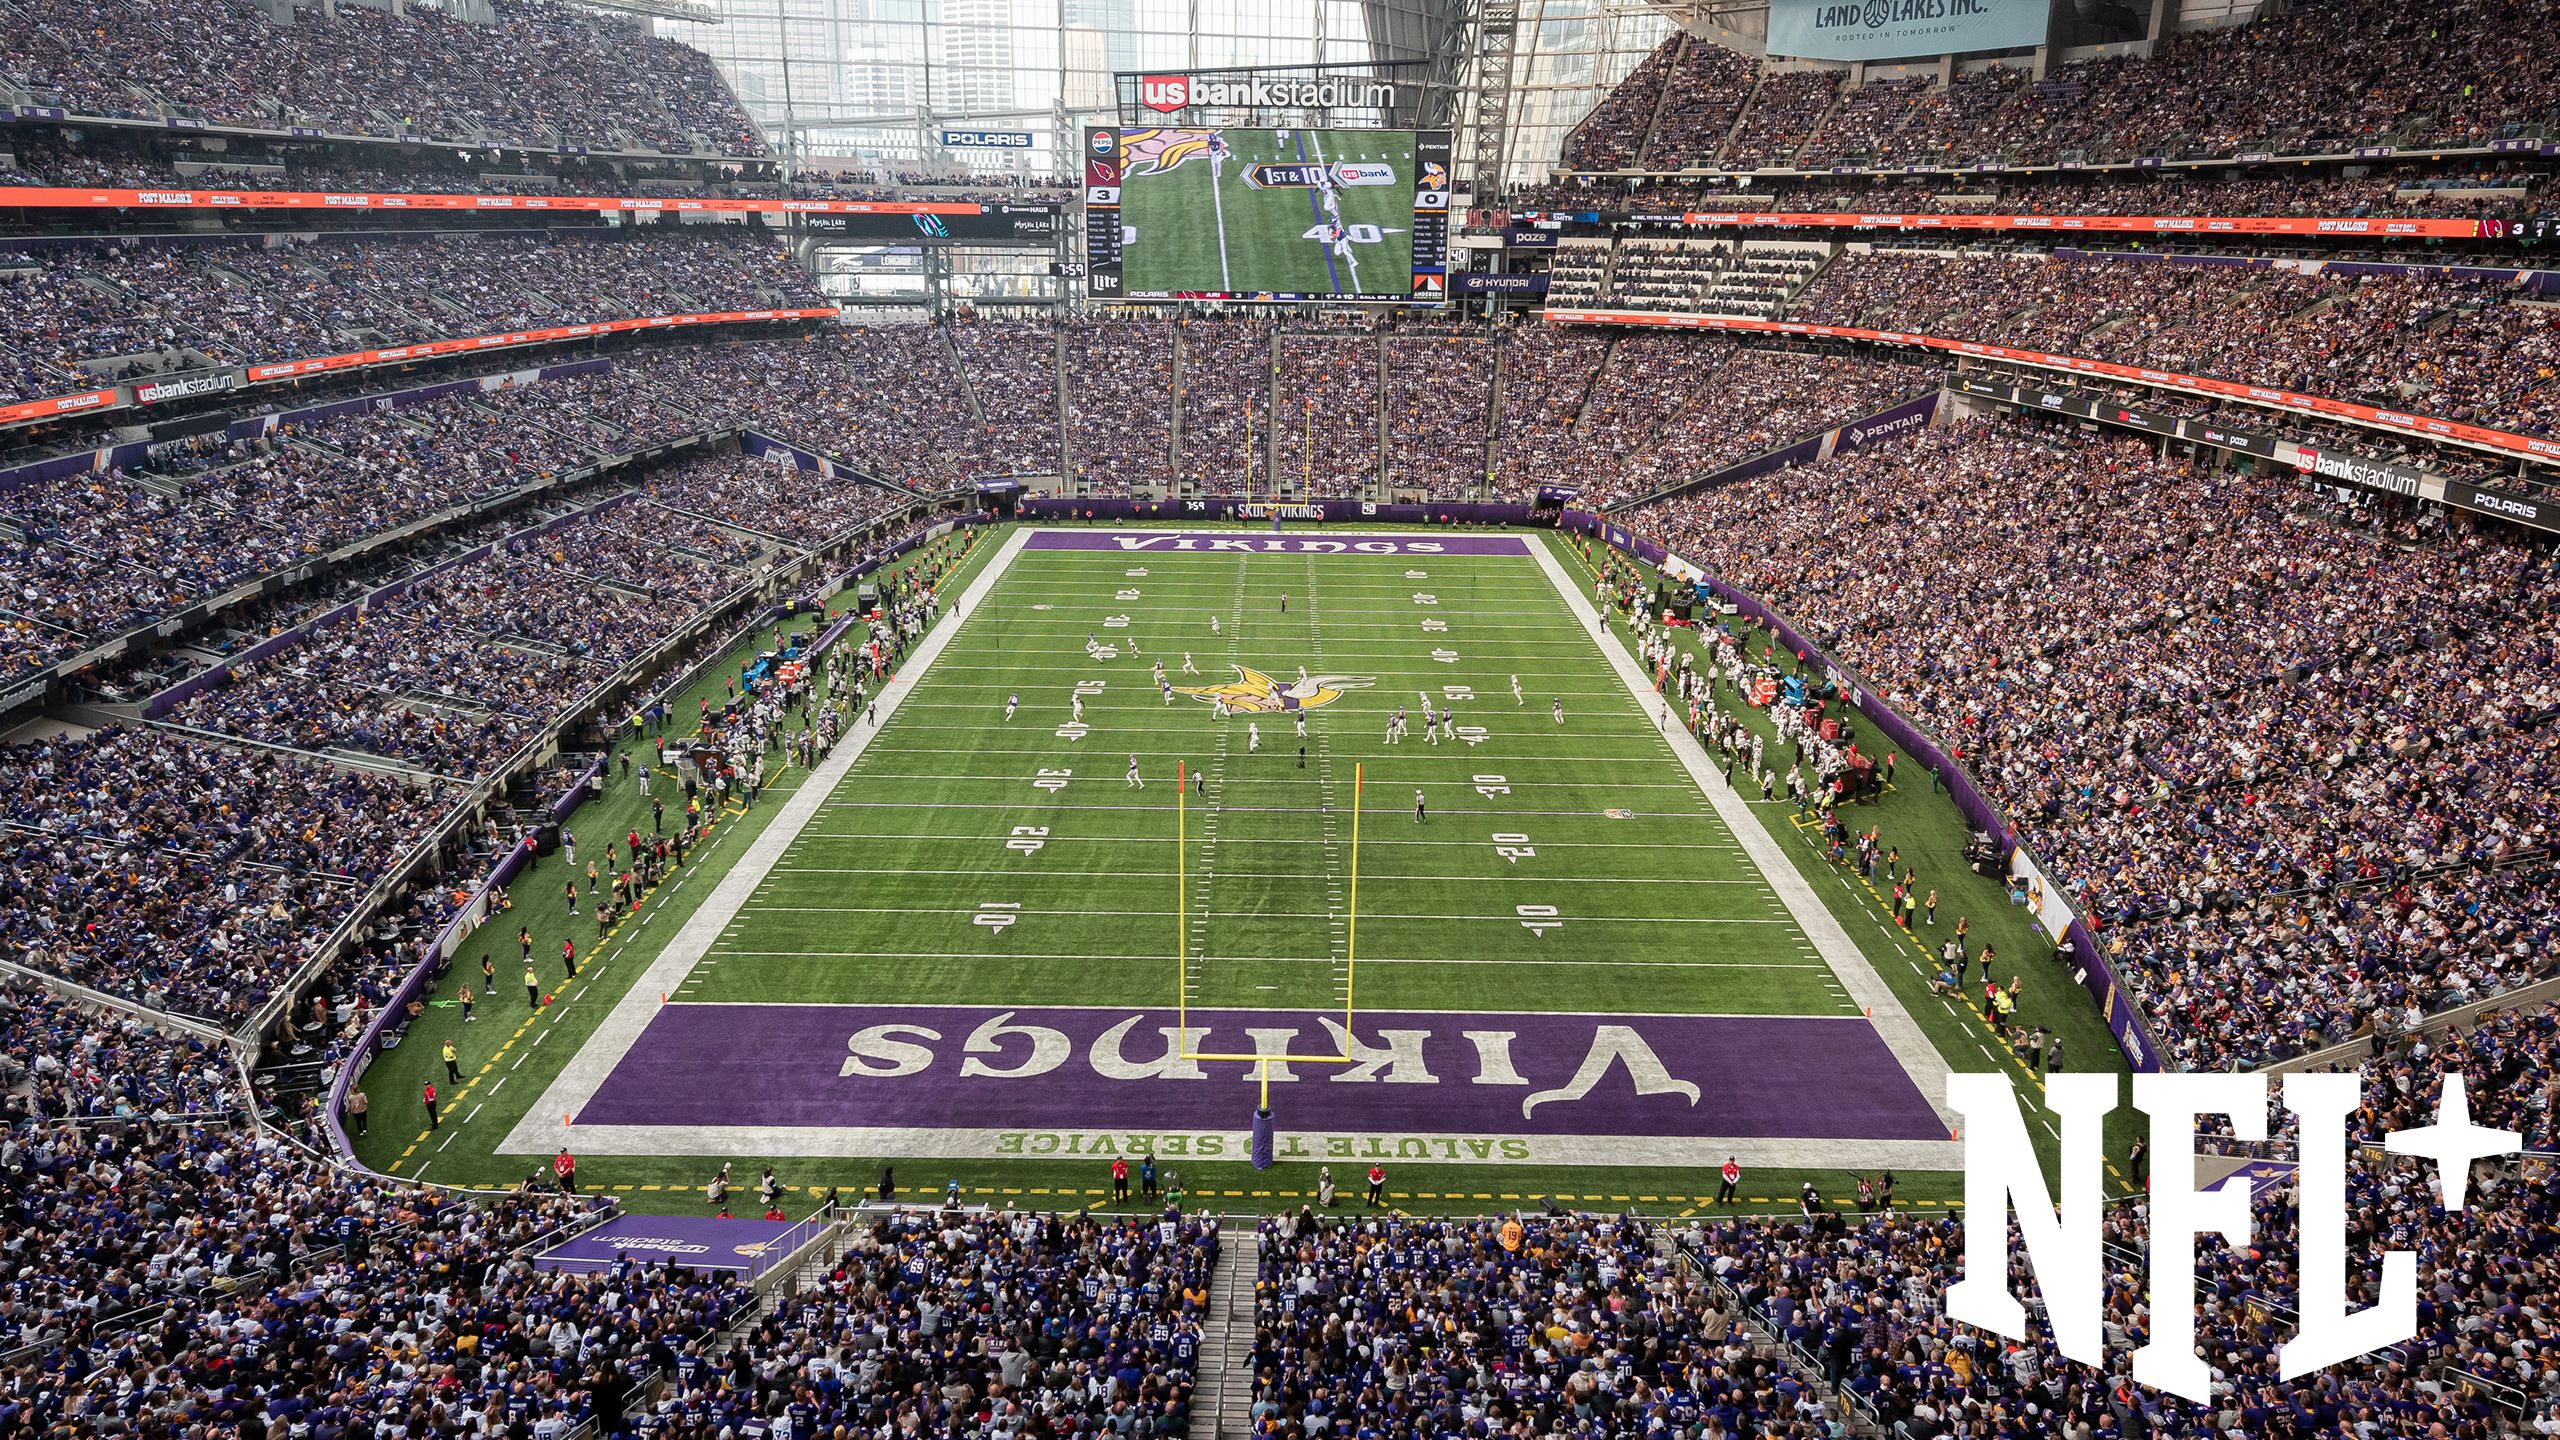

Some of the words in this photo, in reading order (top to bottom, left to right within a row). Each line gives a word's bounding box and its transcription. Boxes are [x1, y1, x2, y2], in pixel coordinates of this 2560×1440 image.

[1816, 6, 1861, 29] LAND
[1950, 0, 1988, 17] INC.
[1835, 33, 1874, 42] ROOTED
[1896, 25, 1956, 37] TOMORROW
[947, 132, 1028, 146] POLARIS
[1289, 171, 1300, 182] &
[138, 192, 158, 204] POST
[158, 193, 192, 204] MALONE
[1097, 190, 1111, 200] 3
[1424, 193, 1439, 205] 0
[782, 202, 800, 210] POST
[1860, 216, 1876, 224] POST
[2317, 221, 2336, 231] POST
[2336, 222, 2369, 232] MALONE
[2385, 224, 2402, 232] JELLY
[2402, 224, 2416, 232] ROLL
[2512, 224, 2524, 234] 3
[2536, 228, 2543, 237] 1
[1516, 232, 1547, 243] paze
[1451, 250, 1466, 261] 40
[1058, 263, 1084, 276] 7:59
[1093, 274, 1118, 291] Lite
[1485, 279, 1529, 288] HYUNDAI
[2376, 411, 2391, 422] POST
[1865, 412, 1924, 443] PENTAIR
[2230, 436, 2248, 448] paze
[2528, 440, 2544, 450] POST
[1186, 501, 1205, 511] 7:59
[1280, 503, 1324, 519] VIKINGS
[1363, 503, 1376, 514] 40
[2474, 493, 2537, 519] POLARIS
[1112, 534, 1445, 556] VIKINGS
[1442, 685, 1475, 700] 50
[1456, 726, 1490, 742] 40
[1032, 768, 1072, 788] 30
[1472, 774, 1511, 794] 30
[1005, 826, 1050, 850] 20
[1492, 833, 1536, 857] 20
[972, 902, 1022, 926] 10
[1516, 904, 1563, 928] 10
[995, 1132, 1224, 1156] SERVICE
[1327, 1136, 1530, 1160] SALUTE
[1164, 1229, 1172, 1240] 3
[1508, 1230, 1517, 1240] 19
[1432, 1254, 1440, 1264] 3
[910, 1262, 924, 1274] 69
[1085, 1285, 1097, 1298] 18
[1285, 1300, 1294, 1311] 18
[1388, 1298, 1402, 1310] 22
[1154, 1328, 1168, 1341] 29
[1511, 1335, 1528, 1347] 22
[1178, 1344, 1192, 1356] 61
[2024, 1359, 2038, 1374] 18
[678, 1367, 694, 1380] 87
[1363, 1371, 1372, 1382] 4
[1097, 1386, 1108, 1398] 18
[795, 1416, 804, 1427] 2
